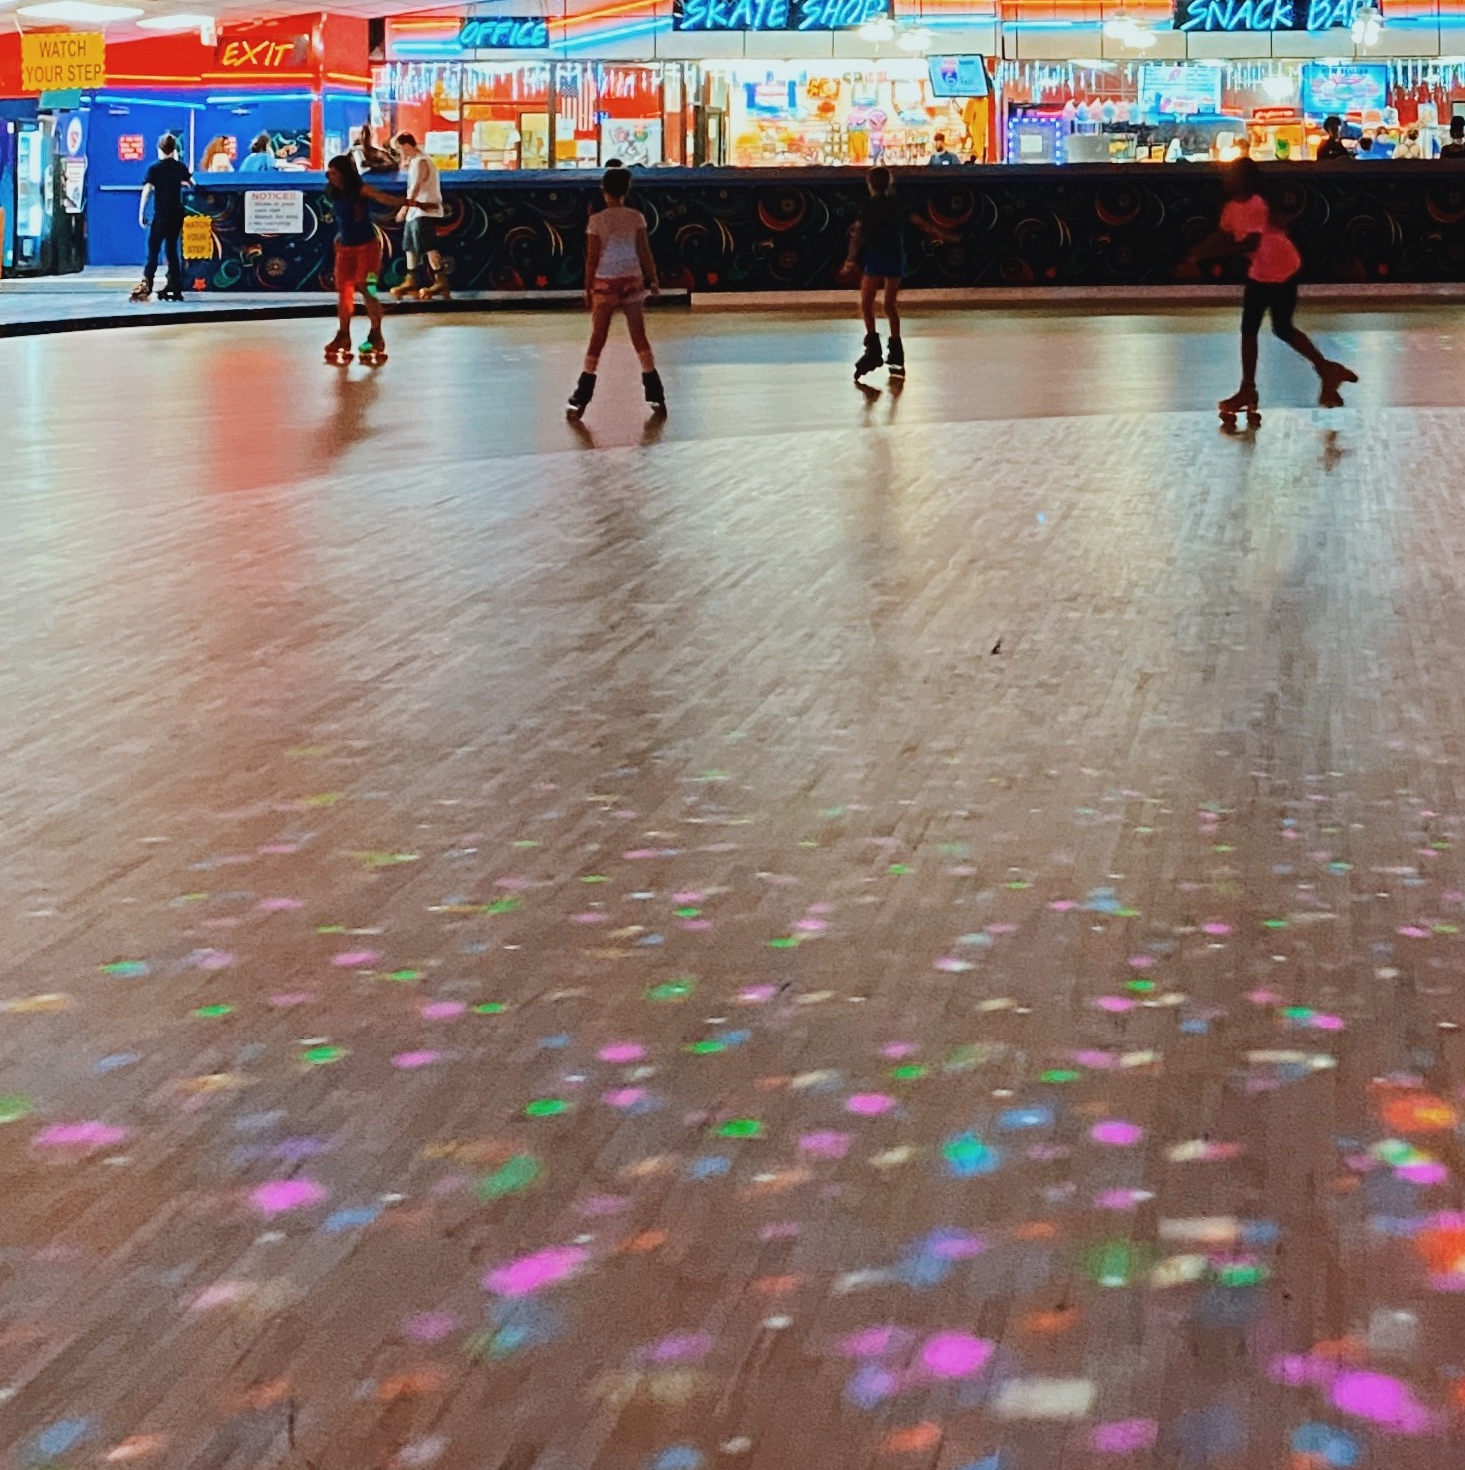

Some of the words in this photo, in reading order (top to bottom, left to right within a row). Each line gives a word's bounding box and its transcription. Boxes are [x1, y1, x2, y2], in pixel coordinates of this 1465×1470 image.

[460, 21, 547, 46] OFFICE
[39, 40, 87, 58] WATCH
[222, 40, 295, 67] EXIT
[26, 64, 63, 84] YOUR
[67, 63, 102, 82] STEP
